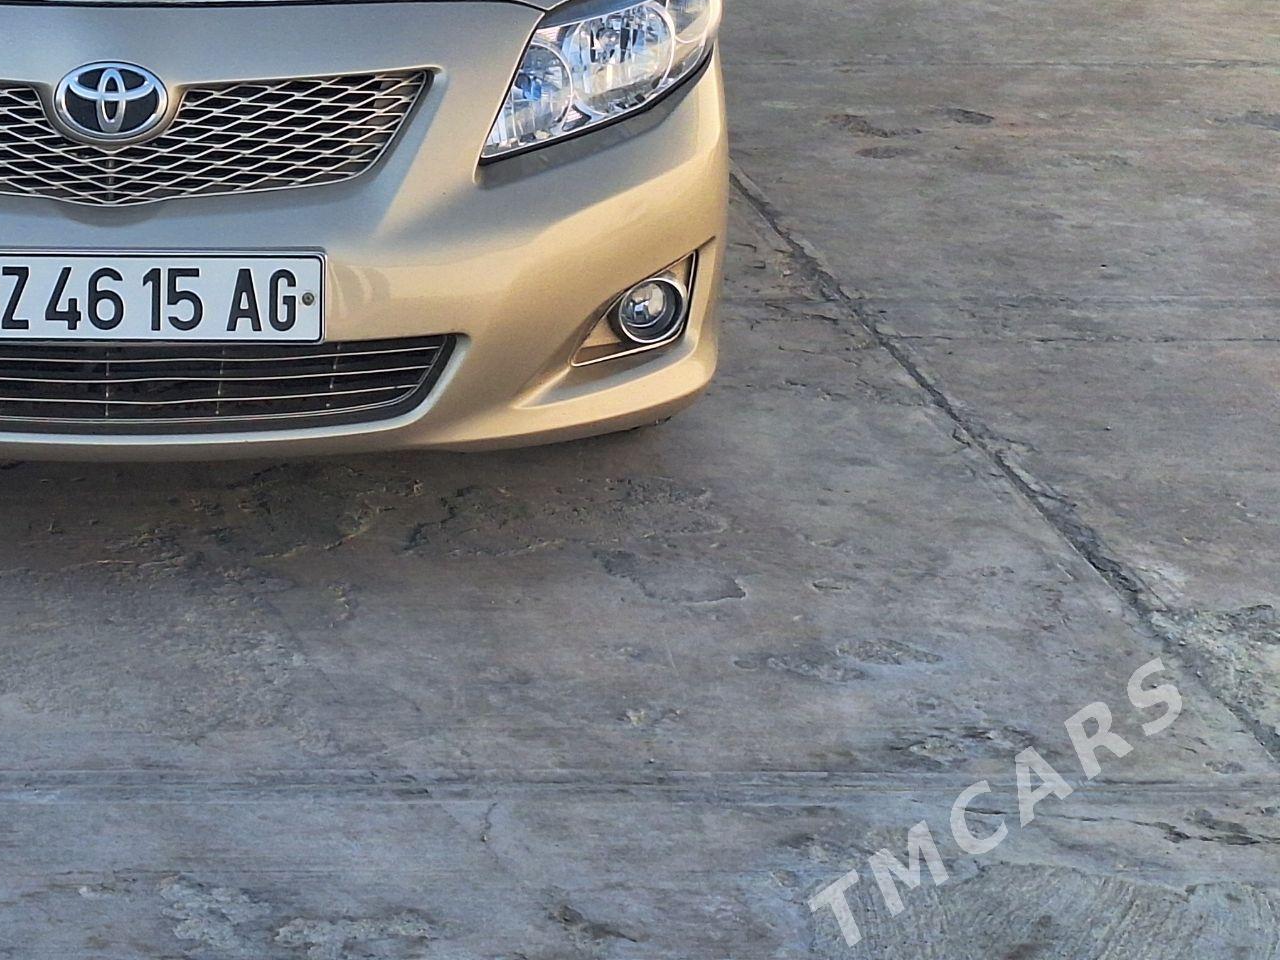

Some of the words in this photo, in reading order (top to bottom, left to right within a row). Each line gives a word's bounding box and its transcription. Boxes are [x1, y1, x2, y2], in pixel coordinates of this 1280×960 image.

[44, 266, 124, 331] 46
[142, 267, 204, 332] 15
[226, 268, 298, 332] AG
